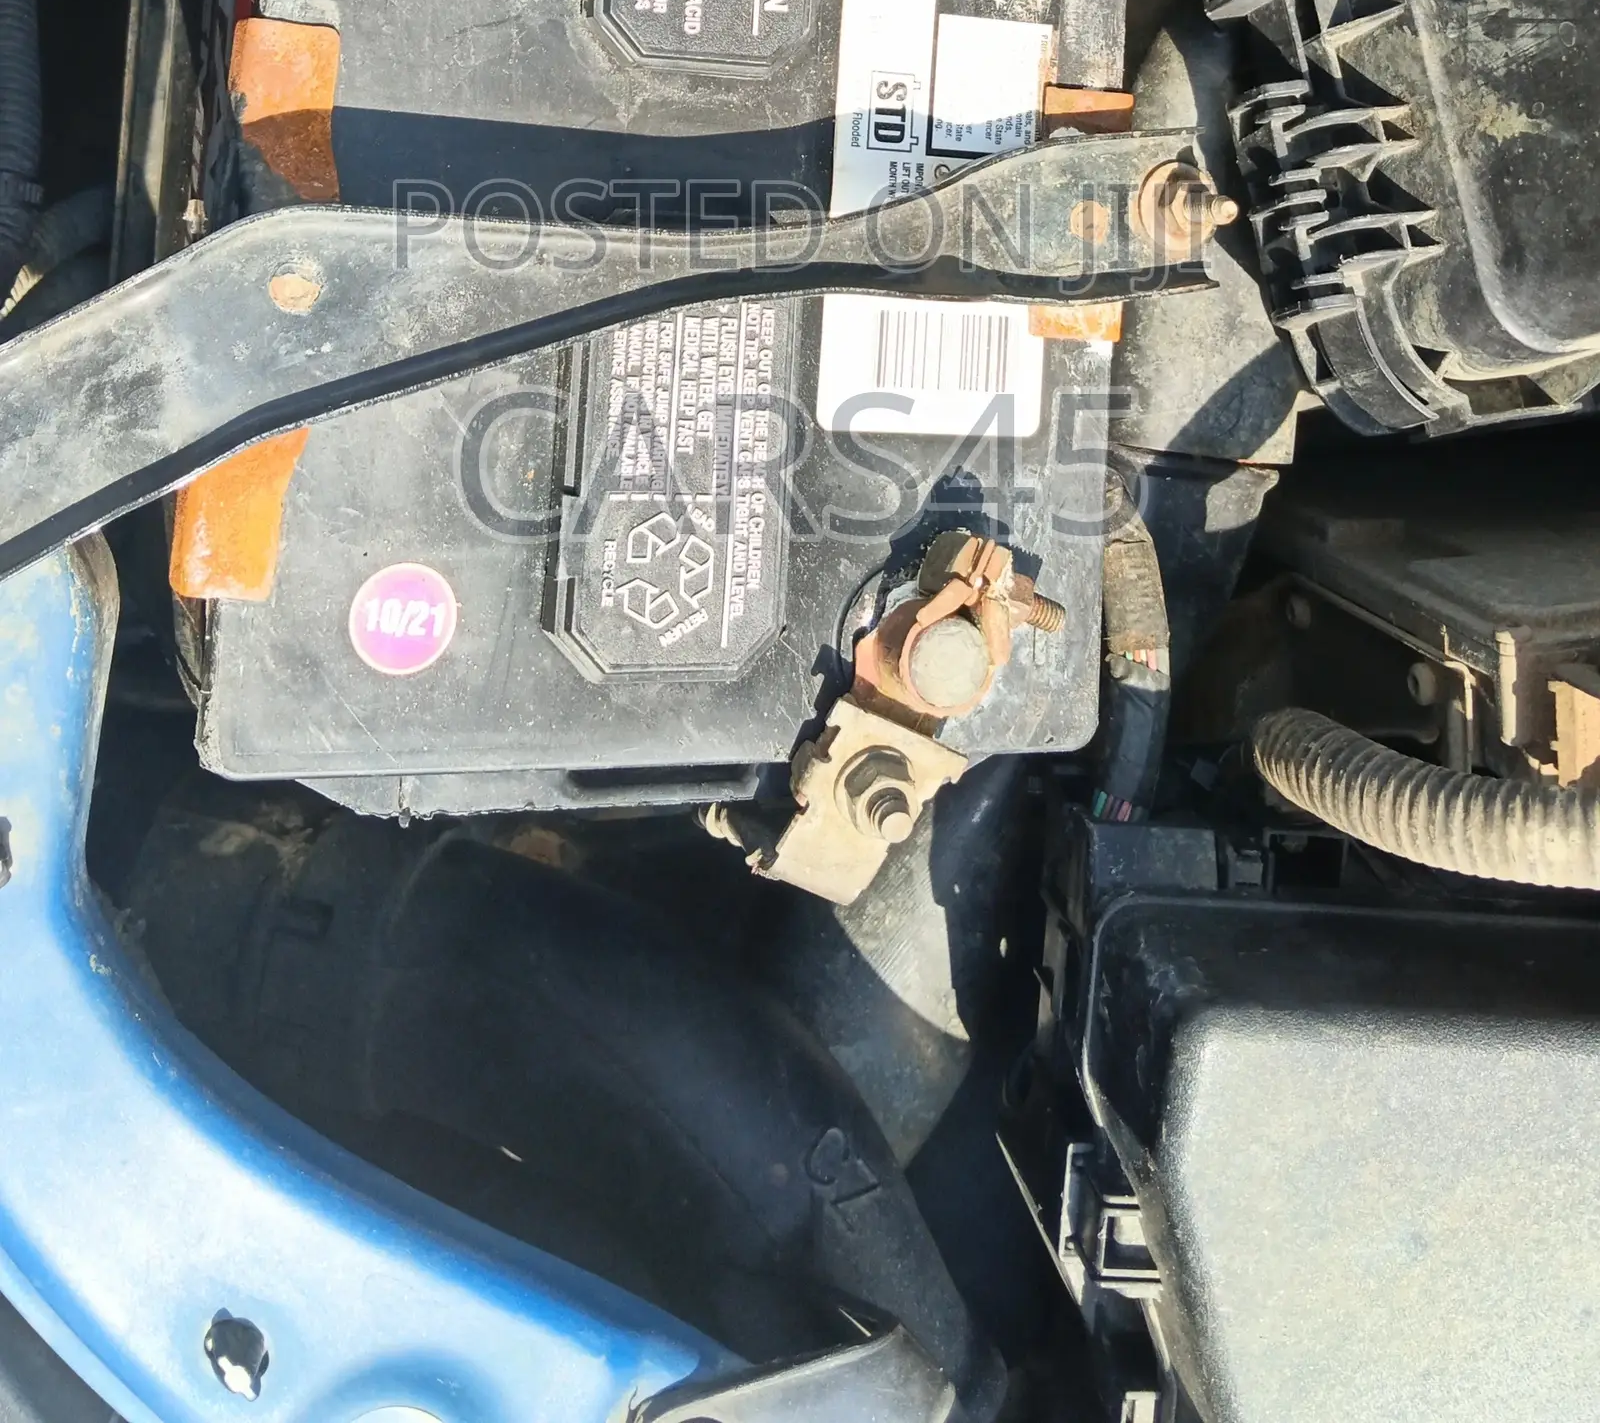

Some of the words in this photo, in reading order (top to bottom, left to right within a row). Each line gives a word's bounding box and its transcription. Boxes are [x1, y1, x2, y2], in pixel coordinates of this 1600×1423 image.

[850, 112, 863, 148] Flooded
[873, 80, 908, 144] STD
[1014, 112, 1023, 138] ontain
[994, 123, 1004, 145] State
[889, 161, 898, 188] MONTH
[901, 179, 910, 194] OUT
[902, 162, 911, 178] LIFT
[660, 321, 674, 348] FOR
[702, 318, 720, 353] WITH
[746, 303, 760, 334] NOT
[760, 308, 775, 345] KEEP
[611, 328, 628, 376] ERVICE
[682, 317, 702, 376] MEDICAL
[720, 318, 738, 362] FLUSH
[658, 351, 673, 385] SAFE
[758, 348, 773, 381] OUT
[626, 376, 640, 390] IF
[679, 379, 698, 416] HELP
[717, 366, 735, 400] EYES
[743, 368, 757, 405] KEEP
[757, 383, 771, 404] OF
[606, 378, 624, 460] ASSISTANCE
[623, 392, 640, 422] NOT
[638, 414, 653, 429] IN
[655, 387, 670, 423] JUMP
[755, 408, 769, 438] THE
[676, 419, 695, 455] FAST
[696, 410, 714, 439] GET
[740, 409, 756, 448] VENT
[620, 422, 637, 491] AVAILABLE
[651, 426, 668, 491] STARTING
[712, 404, 733, 494] IMMEDIATELY
[751, 441, 767, 489] REACH
[737, 450, 752, 489] CAPS
[734, 494, 750, 537] TIGHT
[750, 492, 766, 514] OF
[733, 541, 747, 573] AND
[746, 516, 765, 590] CHILDREN
[601, 539, 617, 608] RECYCLE
[365, 597, 446, 638] 10/21
[658, 606, 709, 648] RETURN
